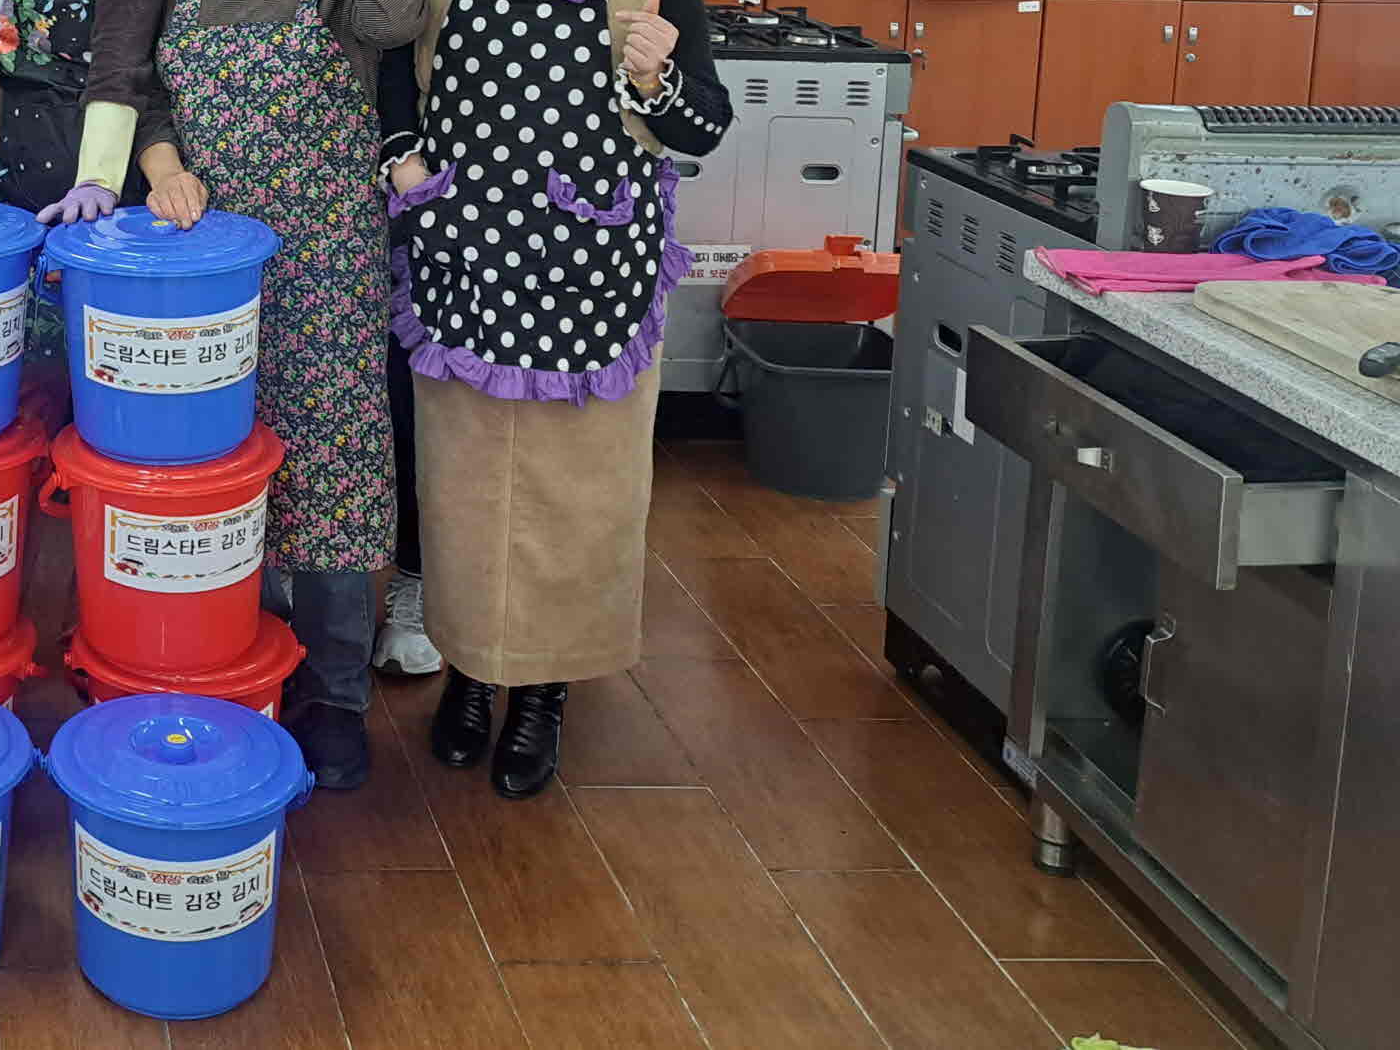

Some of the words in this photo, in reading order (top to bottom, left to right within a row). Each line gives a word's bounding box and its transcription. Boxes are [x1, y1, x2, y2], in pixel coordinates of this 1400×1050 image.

[1, 318, 21, 338] 김치
[103, 342, 187, 366] 드림스타트
[198, 342, 227, 364] 김장
[234, 330, 253, 354] 김치
[127, 534, 212, 556] 드림스타트
[221, 527, 247, 550] 김장
[89, 868, 173, 911] 드림스타트
[185, 891, 221, 912] 김장
[232, 875, 260, 902] 김치
